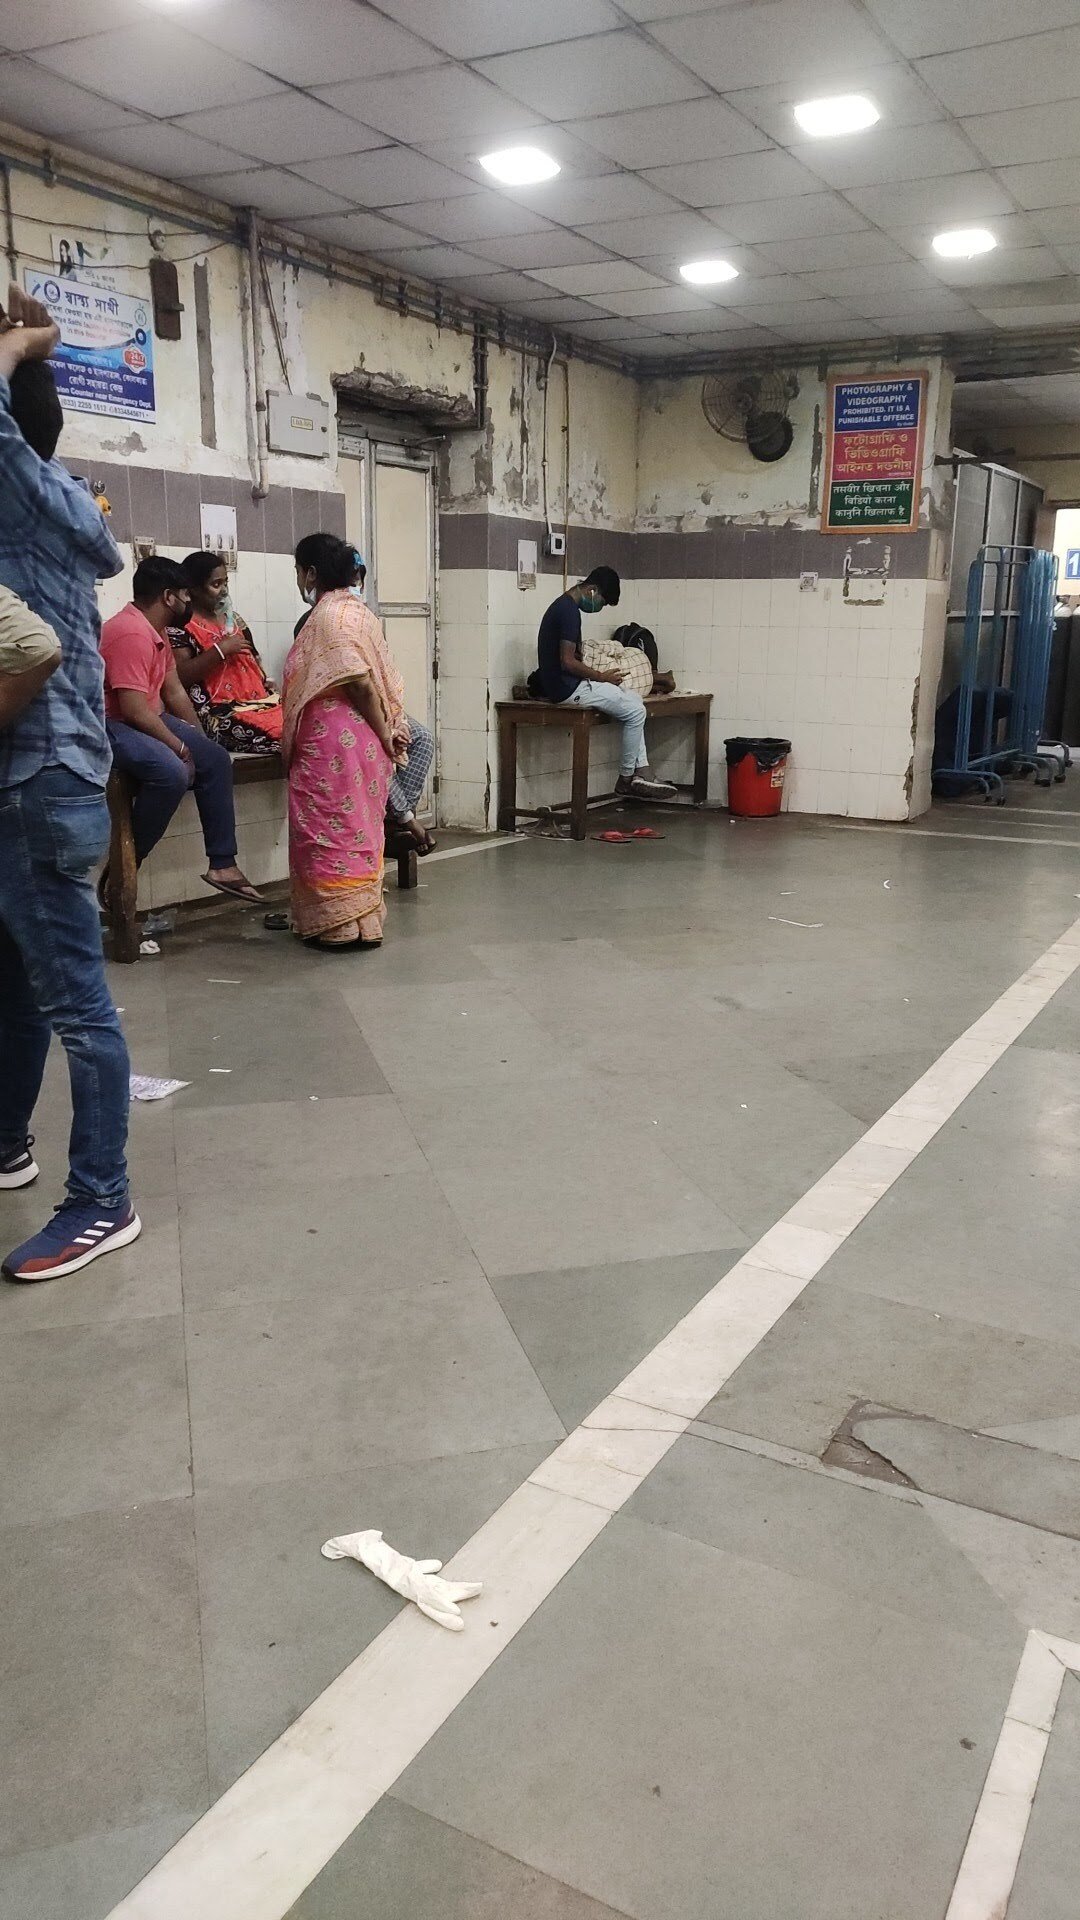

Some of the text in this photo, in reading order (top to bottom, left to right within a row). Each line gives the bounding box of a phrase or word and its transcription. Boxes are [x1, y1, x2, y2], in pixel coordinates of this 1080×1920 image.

[94, 297, 119, 316] সাথী
[841, 382, 913, 395] PHOTOGRAPHY &
[70, 386, 94, 398] Counter
[94, 392, 108, 400] near
[108, 394, 138, 407] Emergency
[847, 395, 907, 406] VIDEOGRAPHY
[904, 404, 911, 412] A
[838, 413, 915, 425] PUNISHABLE OFFENCE
[843, 431, 908, 445] ফটোগ্রাফি ও
[844, 443, 906, 460] ভিডিওগ্রাফি
[835, 460, 874, 473] আইনত
[894, 480, 911, 491] और
[873, 496, 897, 504] करना
[898, 504, 905, 516] है
